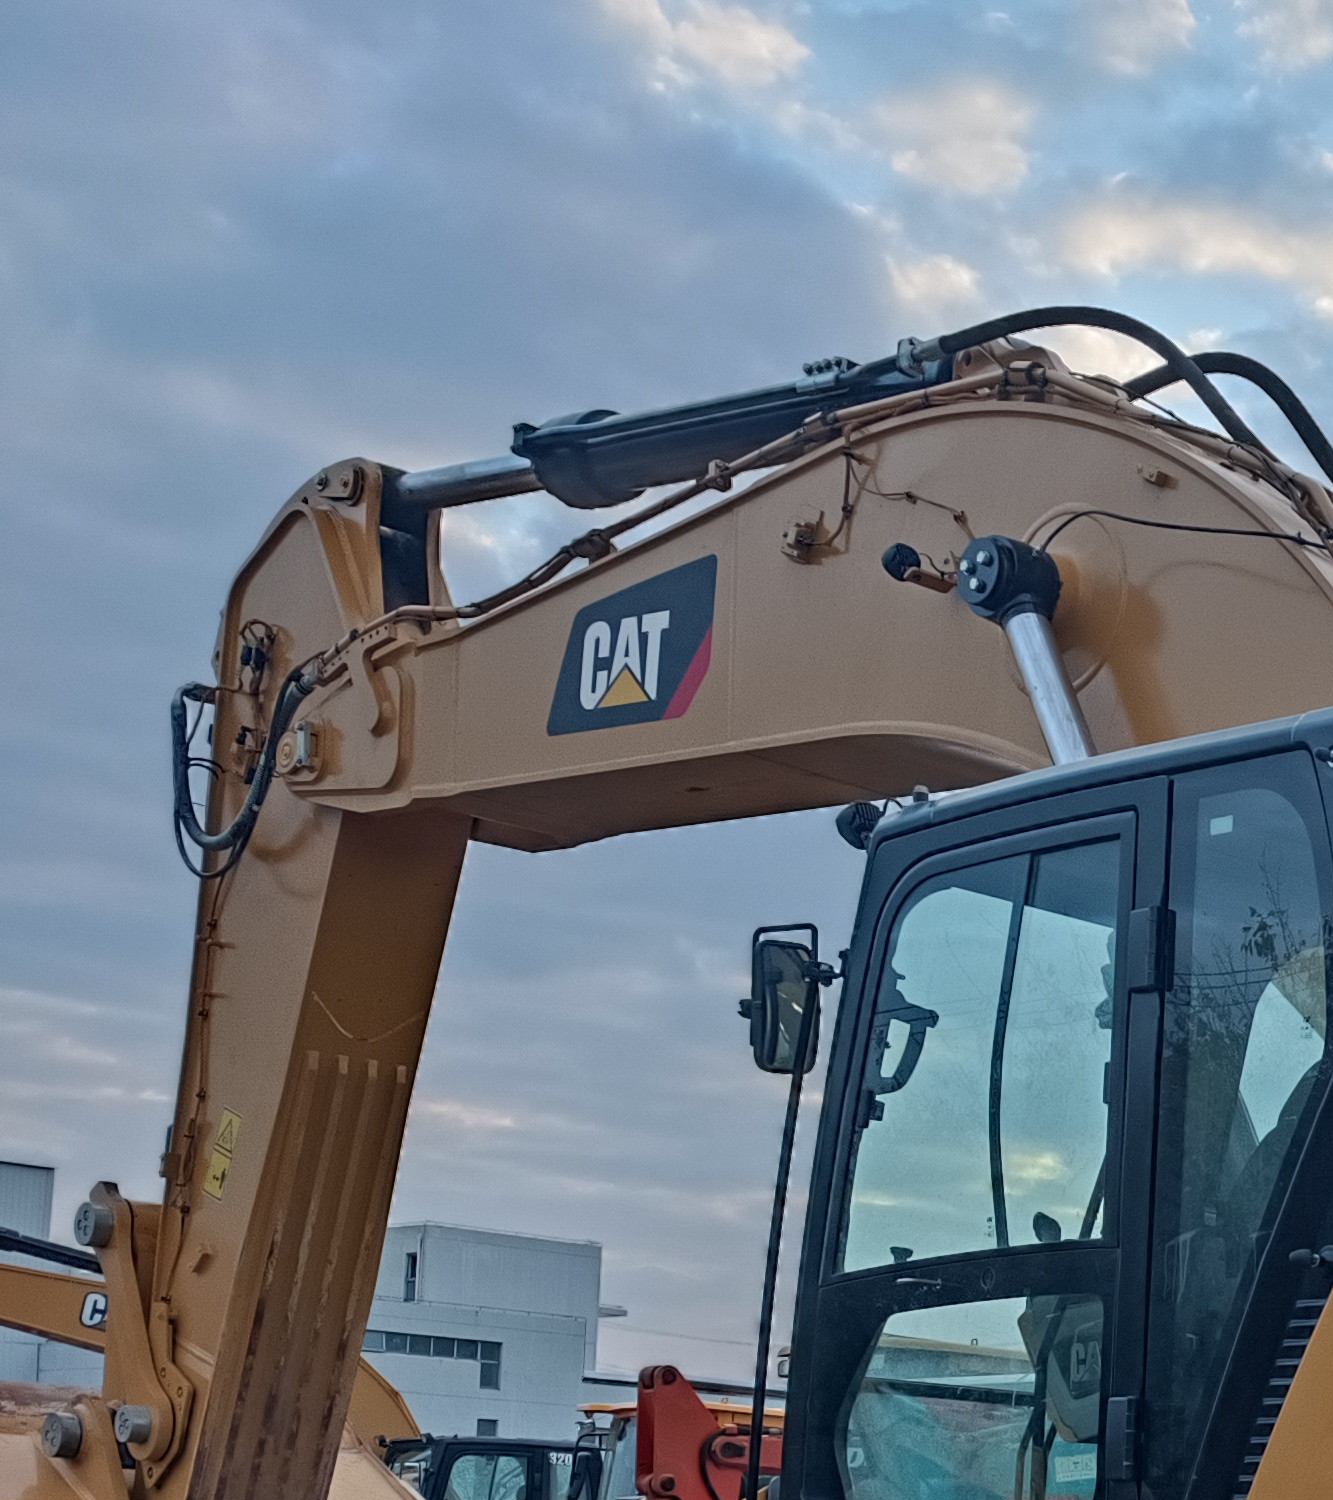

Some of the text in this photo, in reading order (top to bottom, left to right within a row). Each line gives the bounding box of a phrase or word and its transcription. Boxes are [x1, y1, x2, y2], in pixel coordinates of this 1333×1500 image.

[579, 609, 671, 711] CAT
[81, 1293, 108, 1326] C
[549, 1452, 573, 1466] 320
